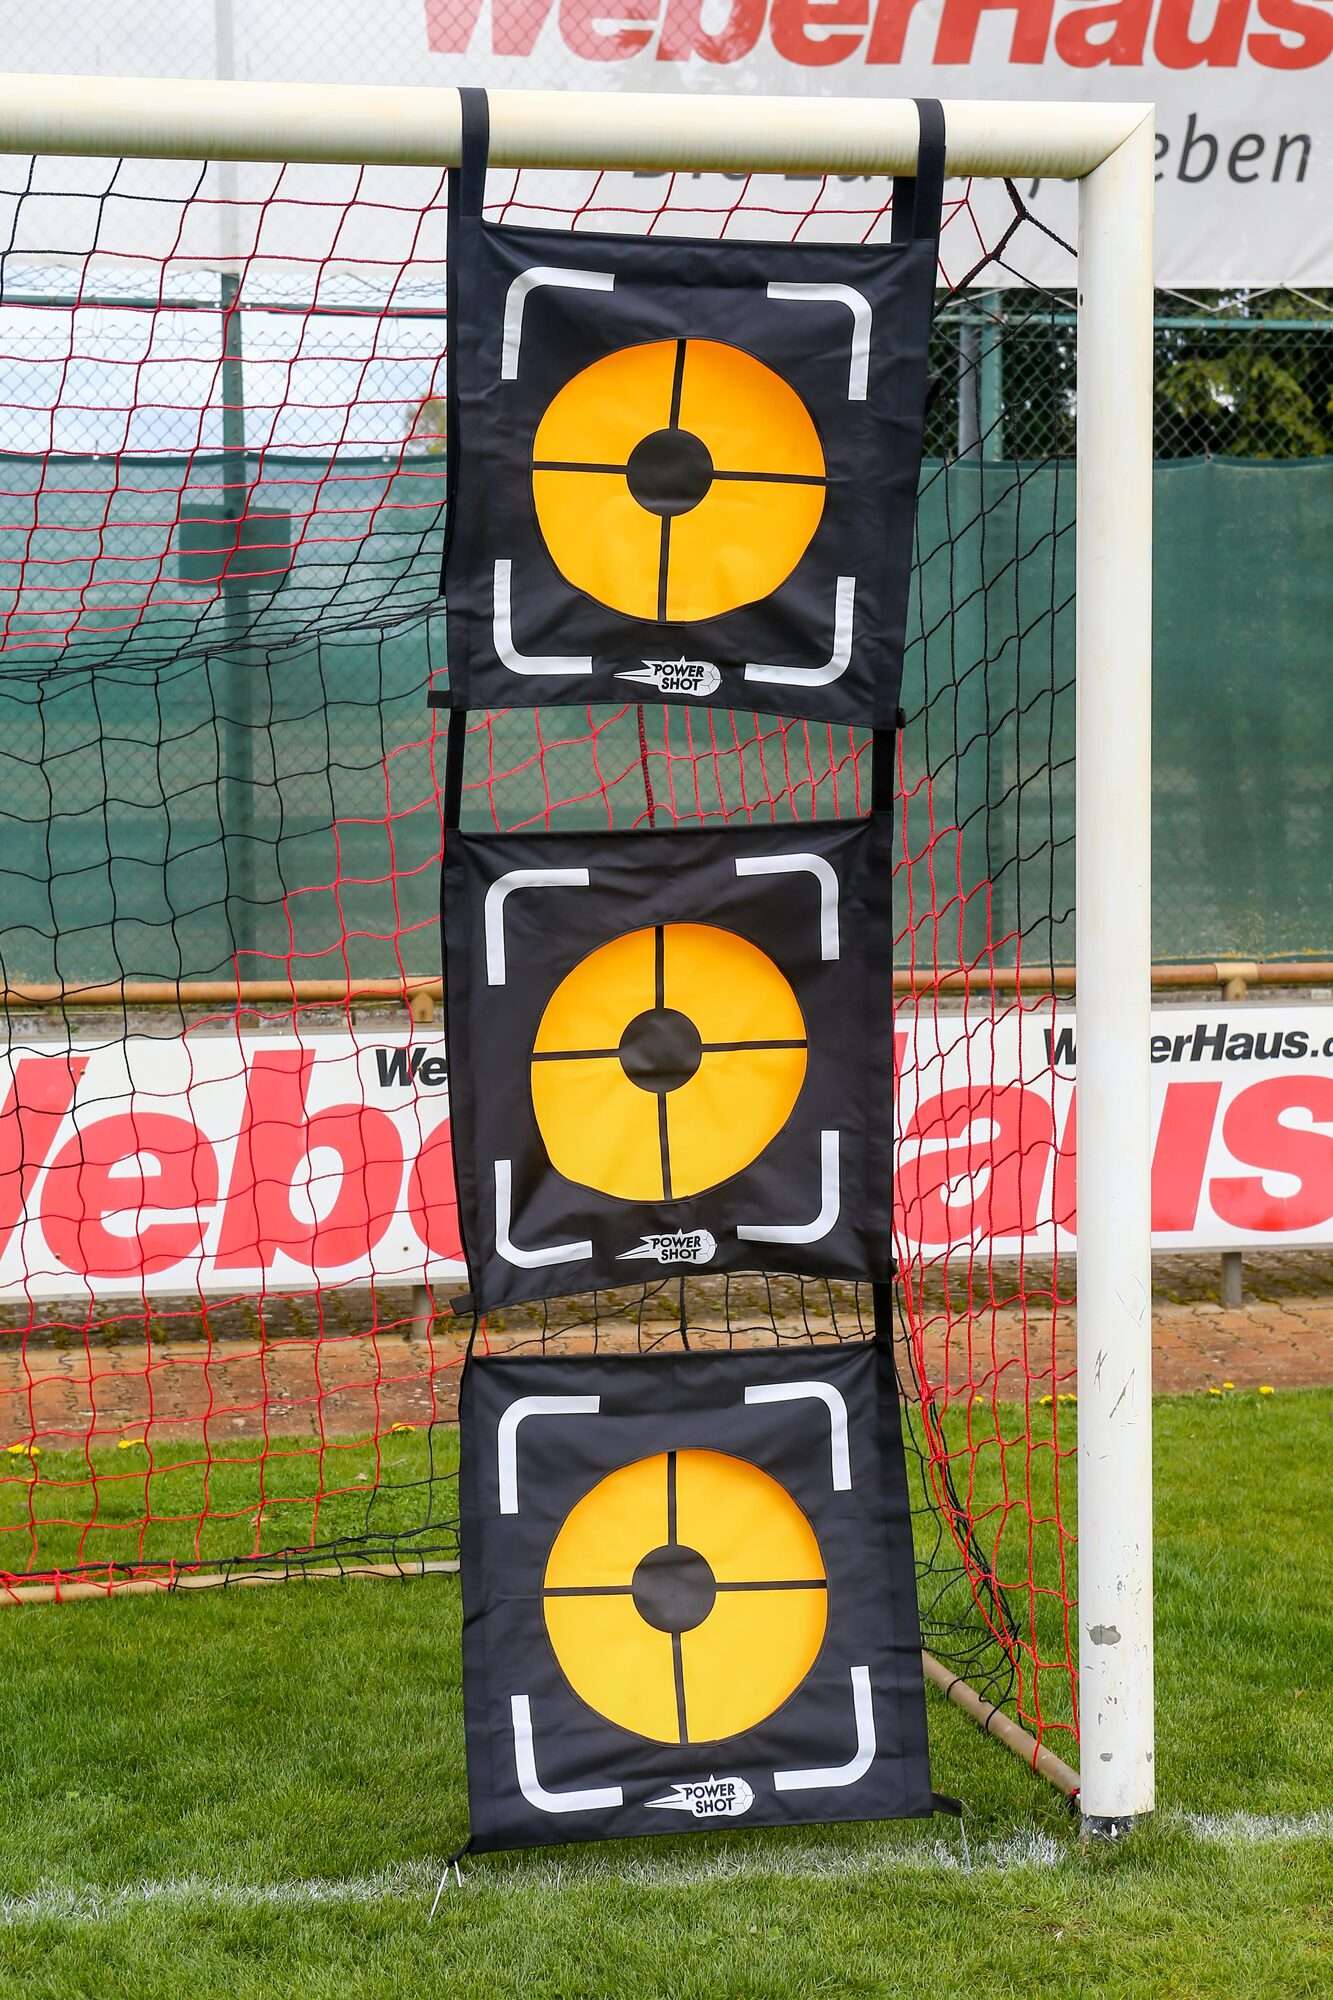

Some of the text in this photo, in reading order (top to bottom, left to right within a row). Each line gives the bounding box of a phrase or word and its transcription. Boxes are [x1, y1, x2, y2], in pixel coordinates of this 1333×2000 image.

[651, 664, 704, 678] POWER
[661, 677, 704, 691] SHOT
[649, 1235, 701, 1250] POWER
[661, 1248, 702, 1261] SHOT
[682, 1783, 736, 1800] POWER
[695, 1797, 737, 1814] SHOT
